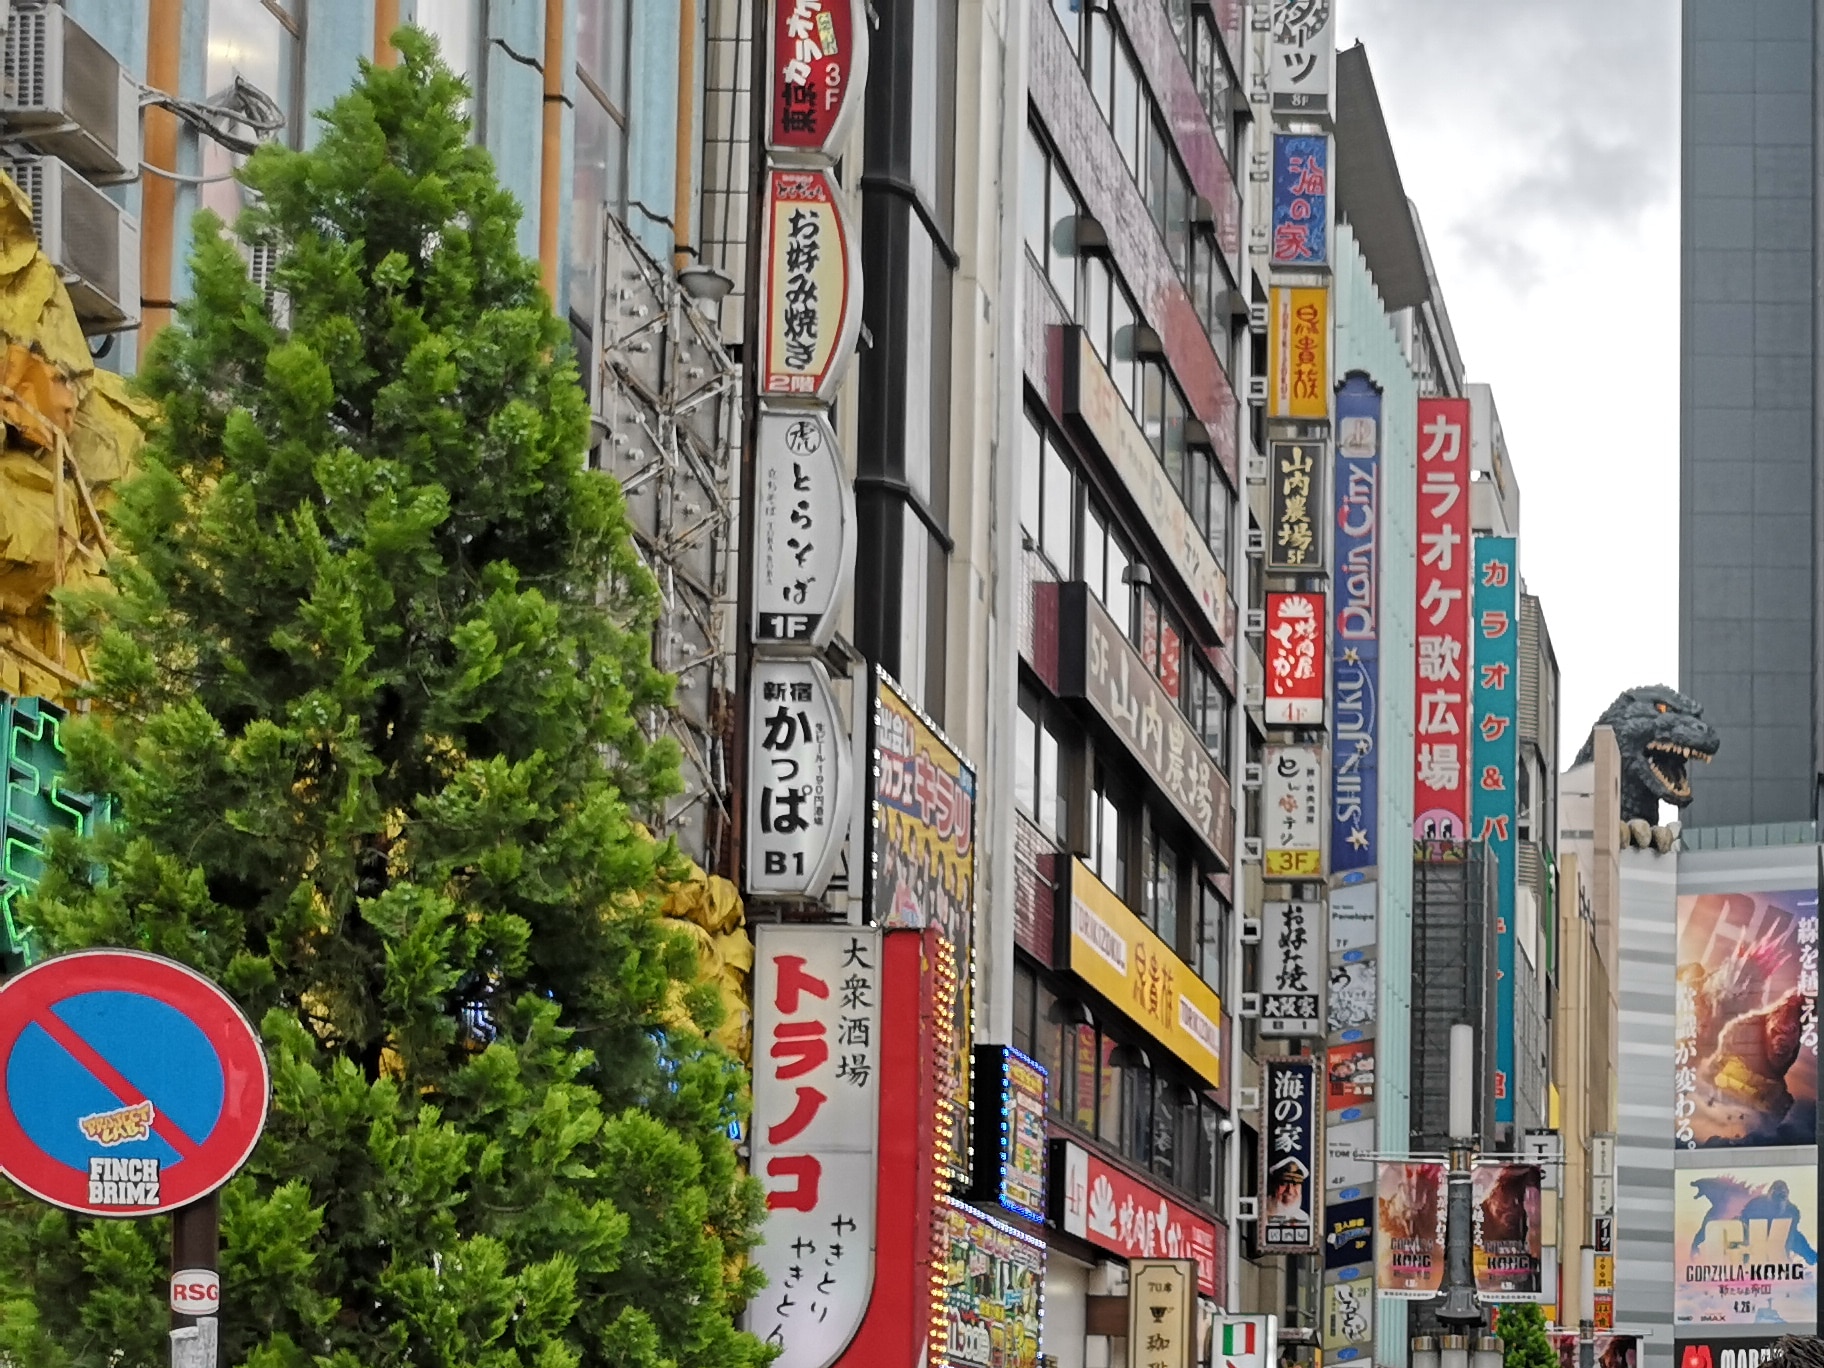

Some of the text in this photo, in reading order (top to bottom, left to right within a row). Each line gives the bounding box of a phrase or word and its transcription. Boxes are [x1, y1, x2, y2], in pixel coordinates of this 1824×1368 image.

[825, 62, 841, 111] 3F
[1275, 155, 1326, 260] 海の家
[784, 207, 821, 370] お好み焼き
[1293, 303, 1319, 400] 鳥貴族
[768, 375, 816, 393] 2階
[1277, 446, 1315, 550] 山内農場
[782, 461, 816, 606] とらそば
[1286, 549, 1306, 565] 5F
[770, 615, 809, 639] 1F
[1417, 415, 1465, 792] カラオケ歌広場
[1090, 641, 1109, 681] 5F
[1269, 621, 1293, 695] さかい
[763, 682, 814, 702] 新宿
[1281, 700, 1308, 724] 4F
[761, 705, 814, 834] かっぱ
[1111, 657, 1215, 838] 山内農場
[879, 752, 913, 806] カフェ
[764, 850, 805, 876] B1
[1279, 853, 1310, 871] 3F
[1133, 942, 1175, 1034] 鳥貴族
[1265, 996, 1316, 1018] 大阪家
[835, 938, 874, 1088] 大衆酒場
[766, 954, 830, 1213] トラノコ
[1274, 1070, 1305, 1153] 海の家
[89, 1181, 160, 1206] BRIMZ
[90, 1158, 159, 1182] FINCH
[810, 1213, 857, 1324] やきとり
[1393, 1253, 1432, 1268] KONG
[1487, 1256, 1529, 1270] KONG
[1686, 1263, 1804, 1283] GODZILLA KONG
[174, 1283, 219, 1301] RSG
